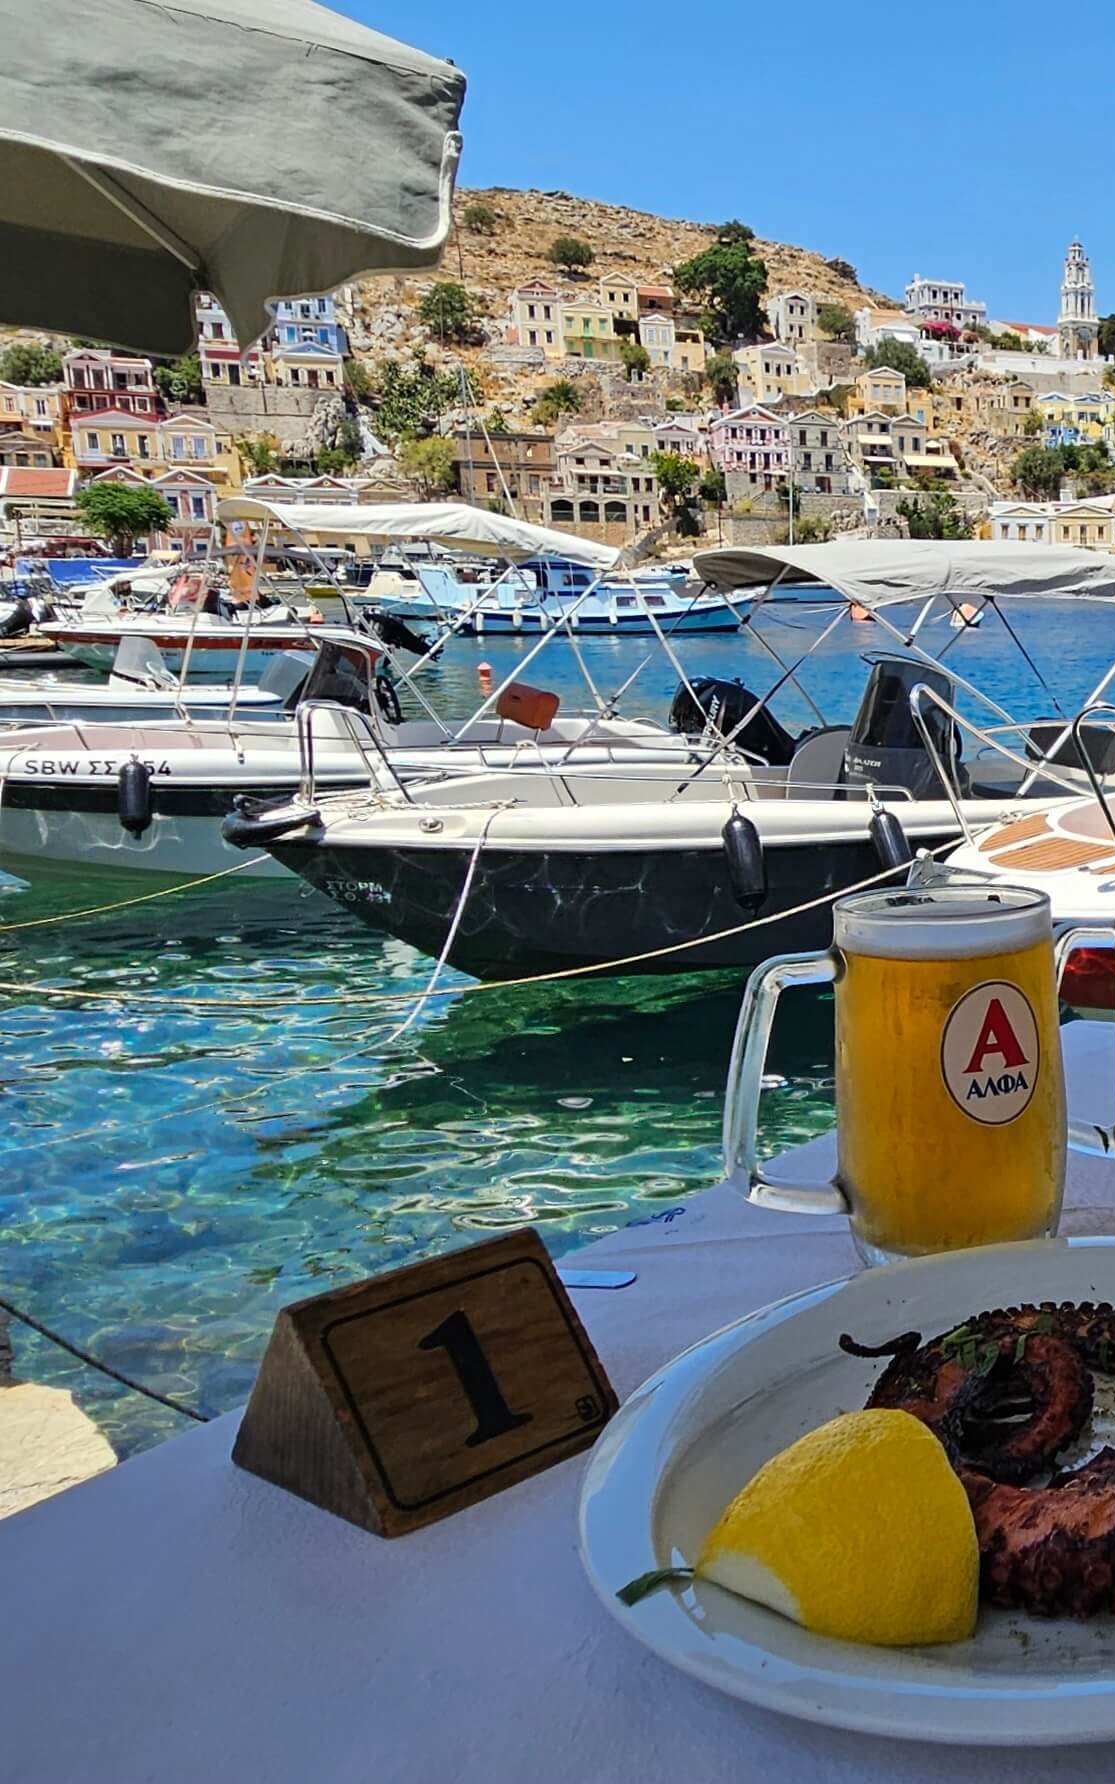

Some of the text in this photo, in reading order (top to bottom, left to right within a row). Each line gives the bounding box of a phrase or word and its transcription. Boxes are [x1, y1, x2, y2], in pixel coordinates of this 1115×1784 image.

[24, 760, 171, 776] SBW ΣΣ 54
[966, 1070, 1029, 1101] ΑΛΦΑ
[417, 1310, 534, 1448] 1
